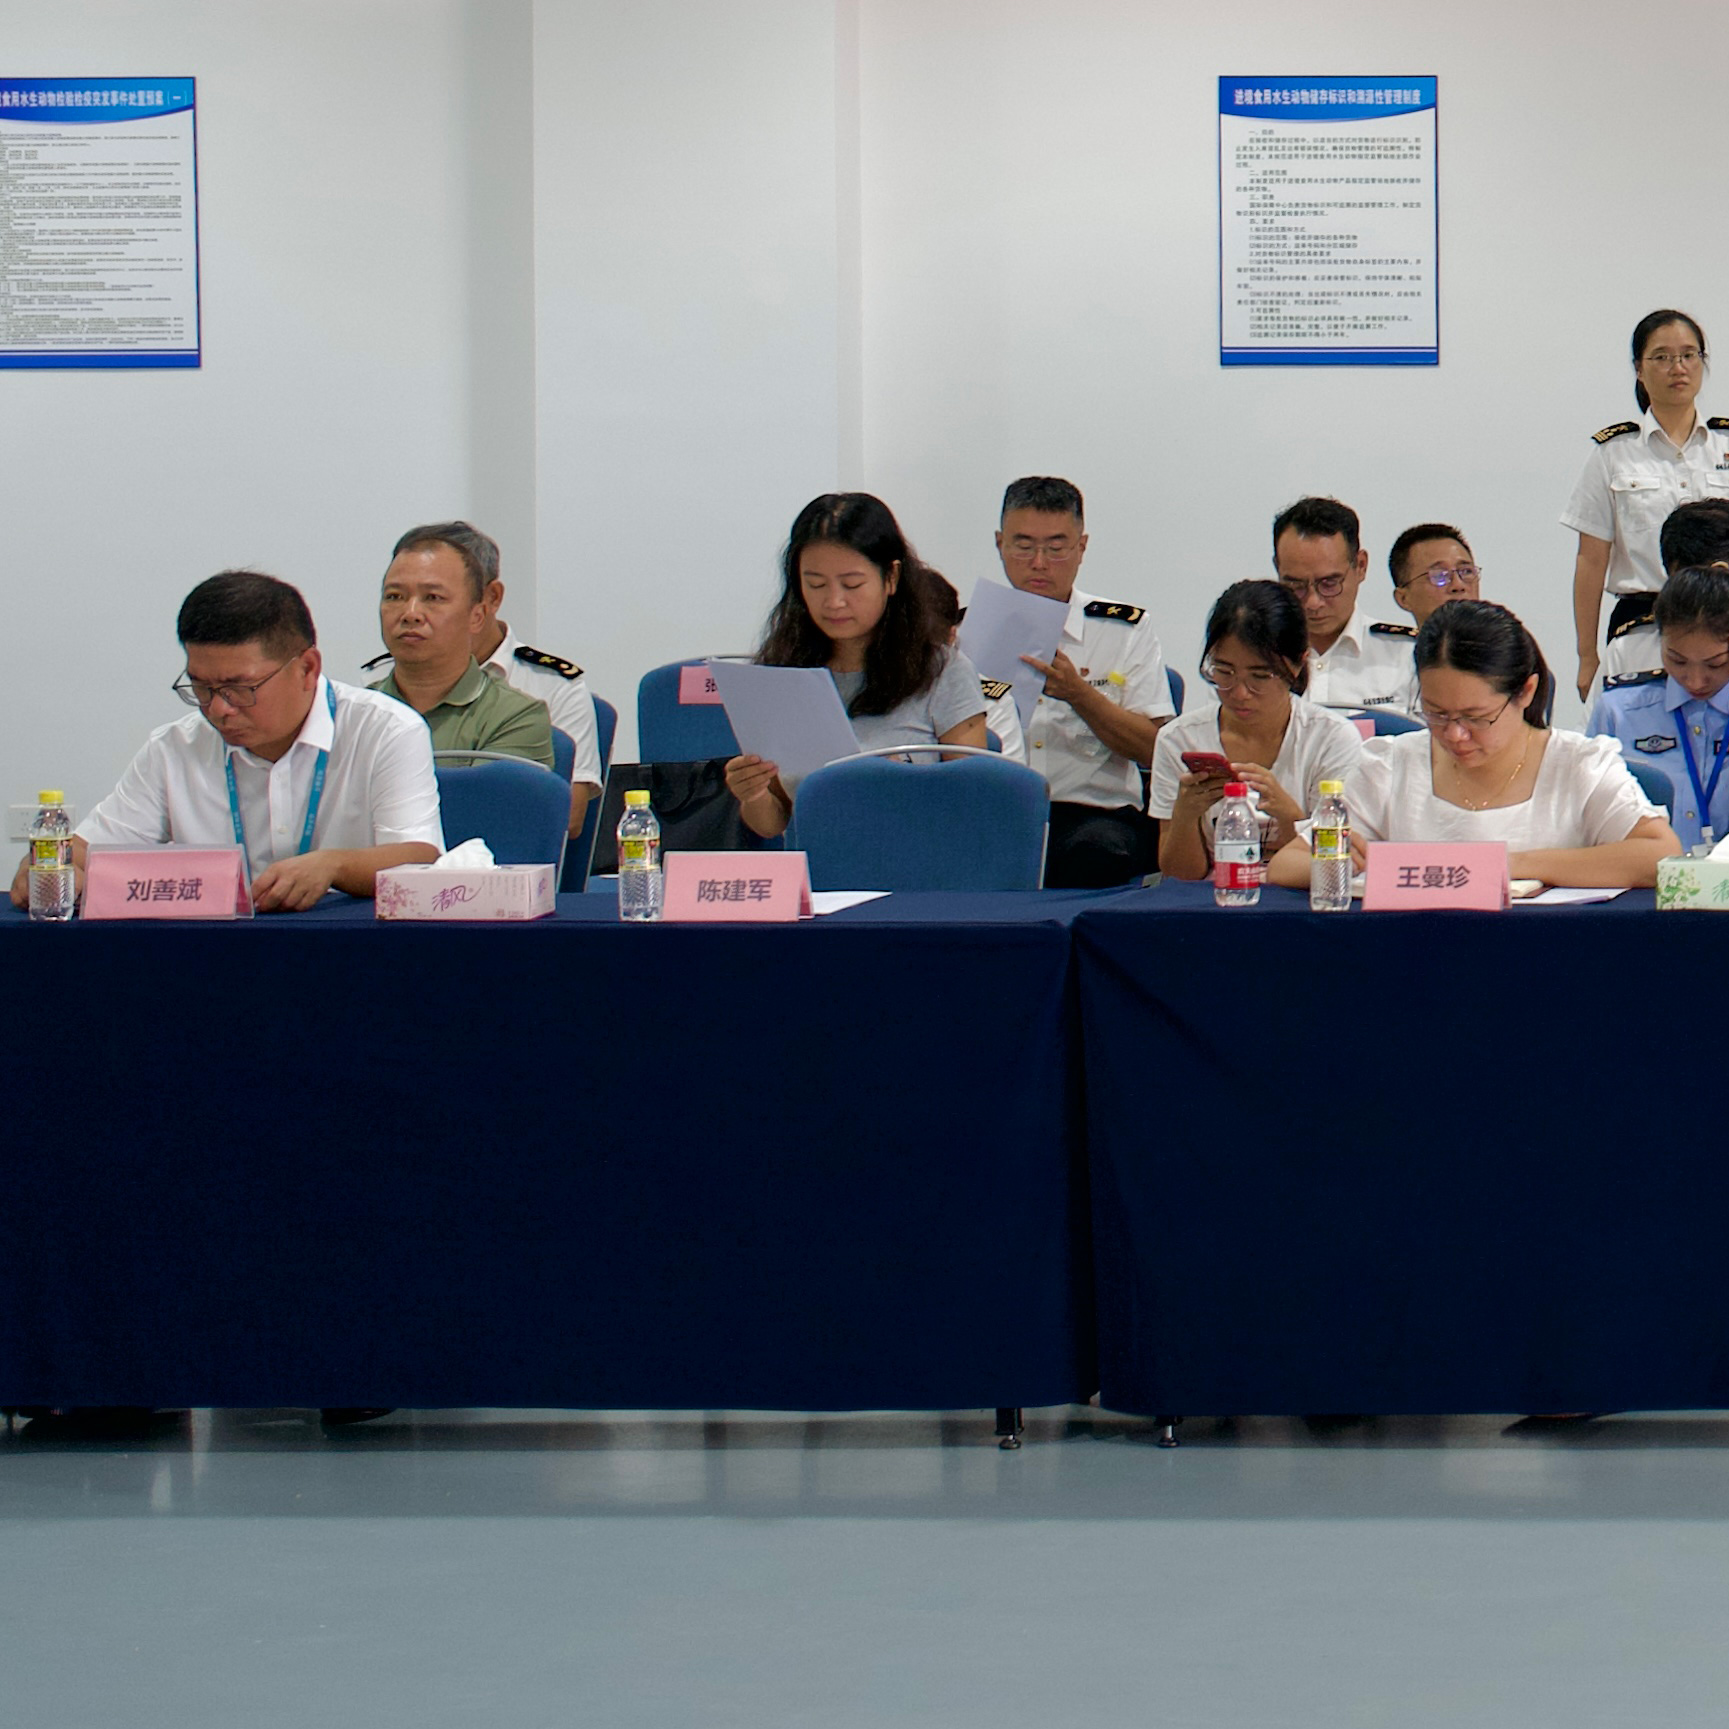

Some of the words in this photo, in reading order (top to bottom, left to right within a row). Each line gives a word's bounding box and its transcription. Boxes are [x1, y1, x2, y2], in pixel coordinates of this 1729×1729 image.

[126, 877, 203, 902] 刘善斌
[1396, 865, 1471, 889] 王曼珍
[431, 885, 483, 913] 清风
[696, 878, 773, 903] 陈建军
